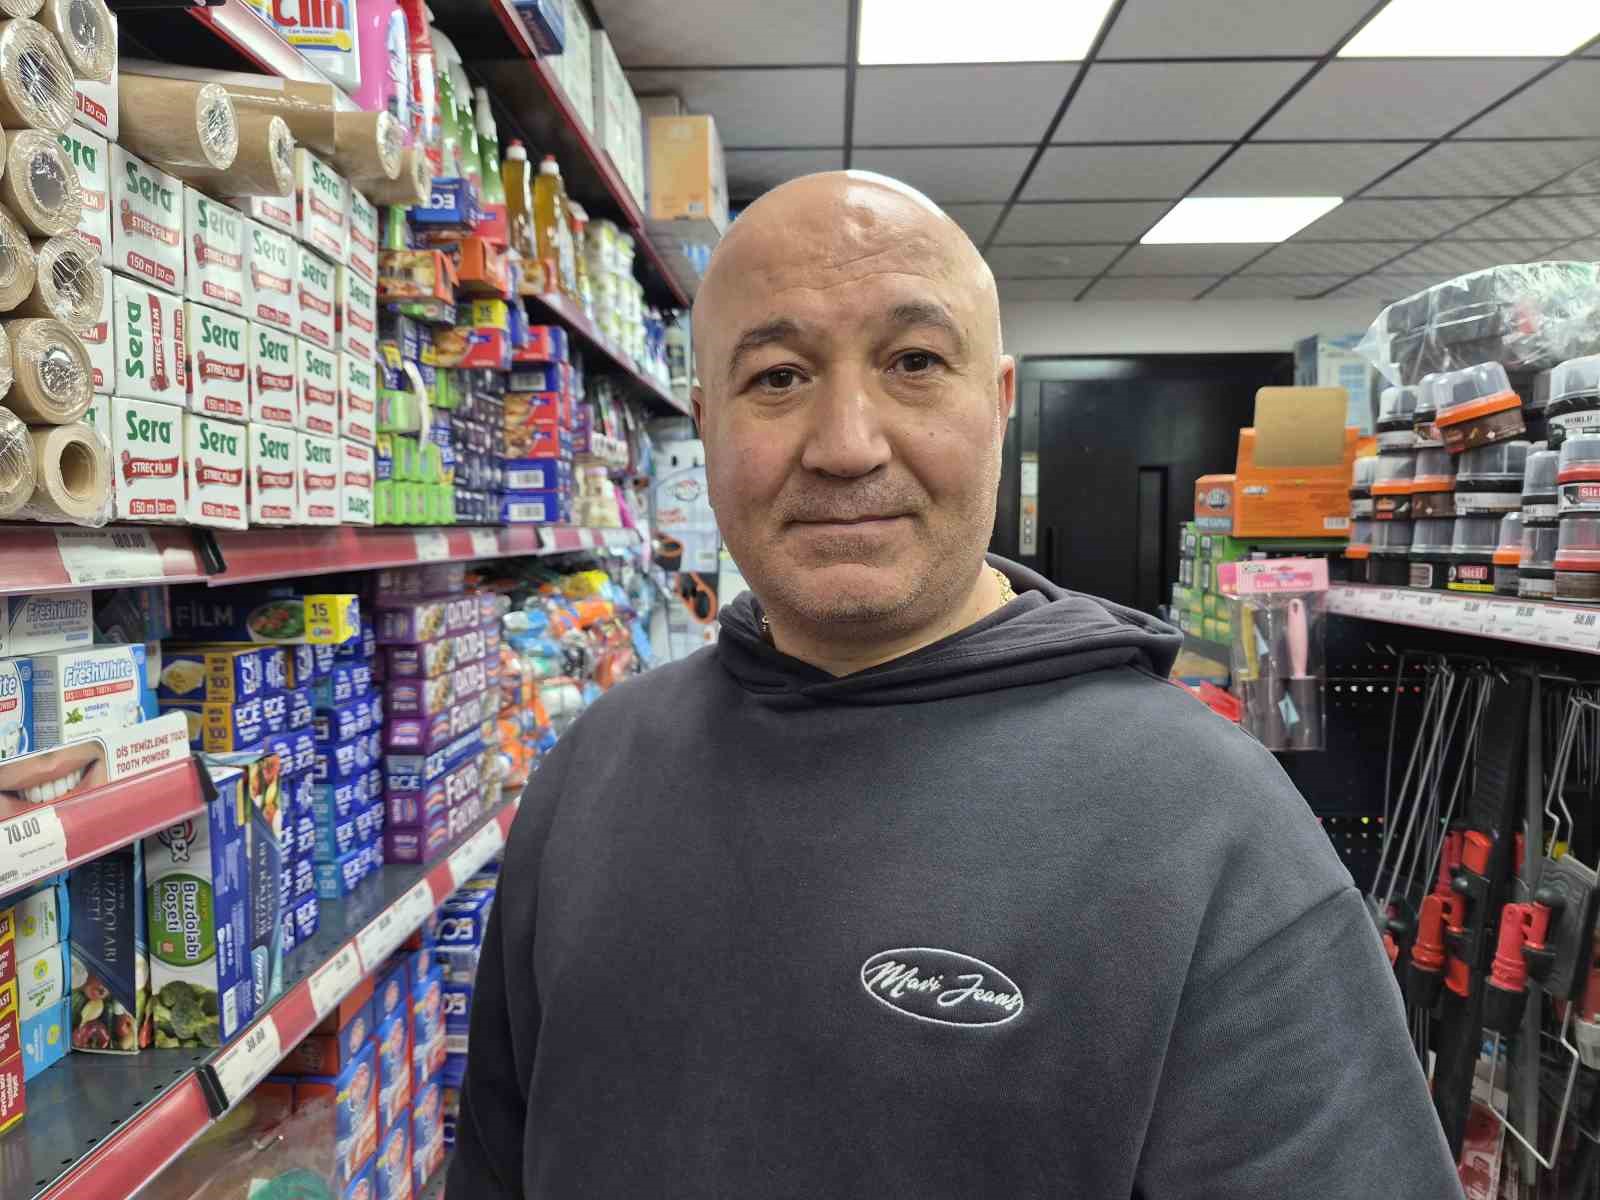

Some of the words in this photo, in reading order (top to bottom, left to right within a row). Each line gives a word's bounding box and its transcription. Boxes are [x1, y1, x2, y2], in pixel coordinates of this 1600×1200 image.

[126, 160, 174, 214] Sera
[198, 199, 236, 241] Sera
[253, 230, 288, 266] Sera
[126, 301, 144, 379] Sera
[201, 315, 240, 351] Sera
[258, 332, 289, 363] Sera
[126, 409, 172, 445] Sera
[199, 422, 238, 456] Sera
[258, 432, 290, 462] Sera
[131, 500, 145, 514] 150
[311, 602, 329, 617] 15
[64, 658, 134, 688] FreshWhite
[4, 816, 41, 845] 70.00
[161, 880, 183, 934] Poşeti
[182, 879, 200, 961] Buzdolabı
[864, 960, 945, 999] Mavi
[936, 974, 1024, 1011] Jeans
